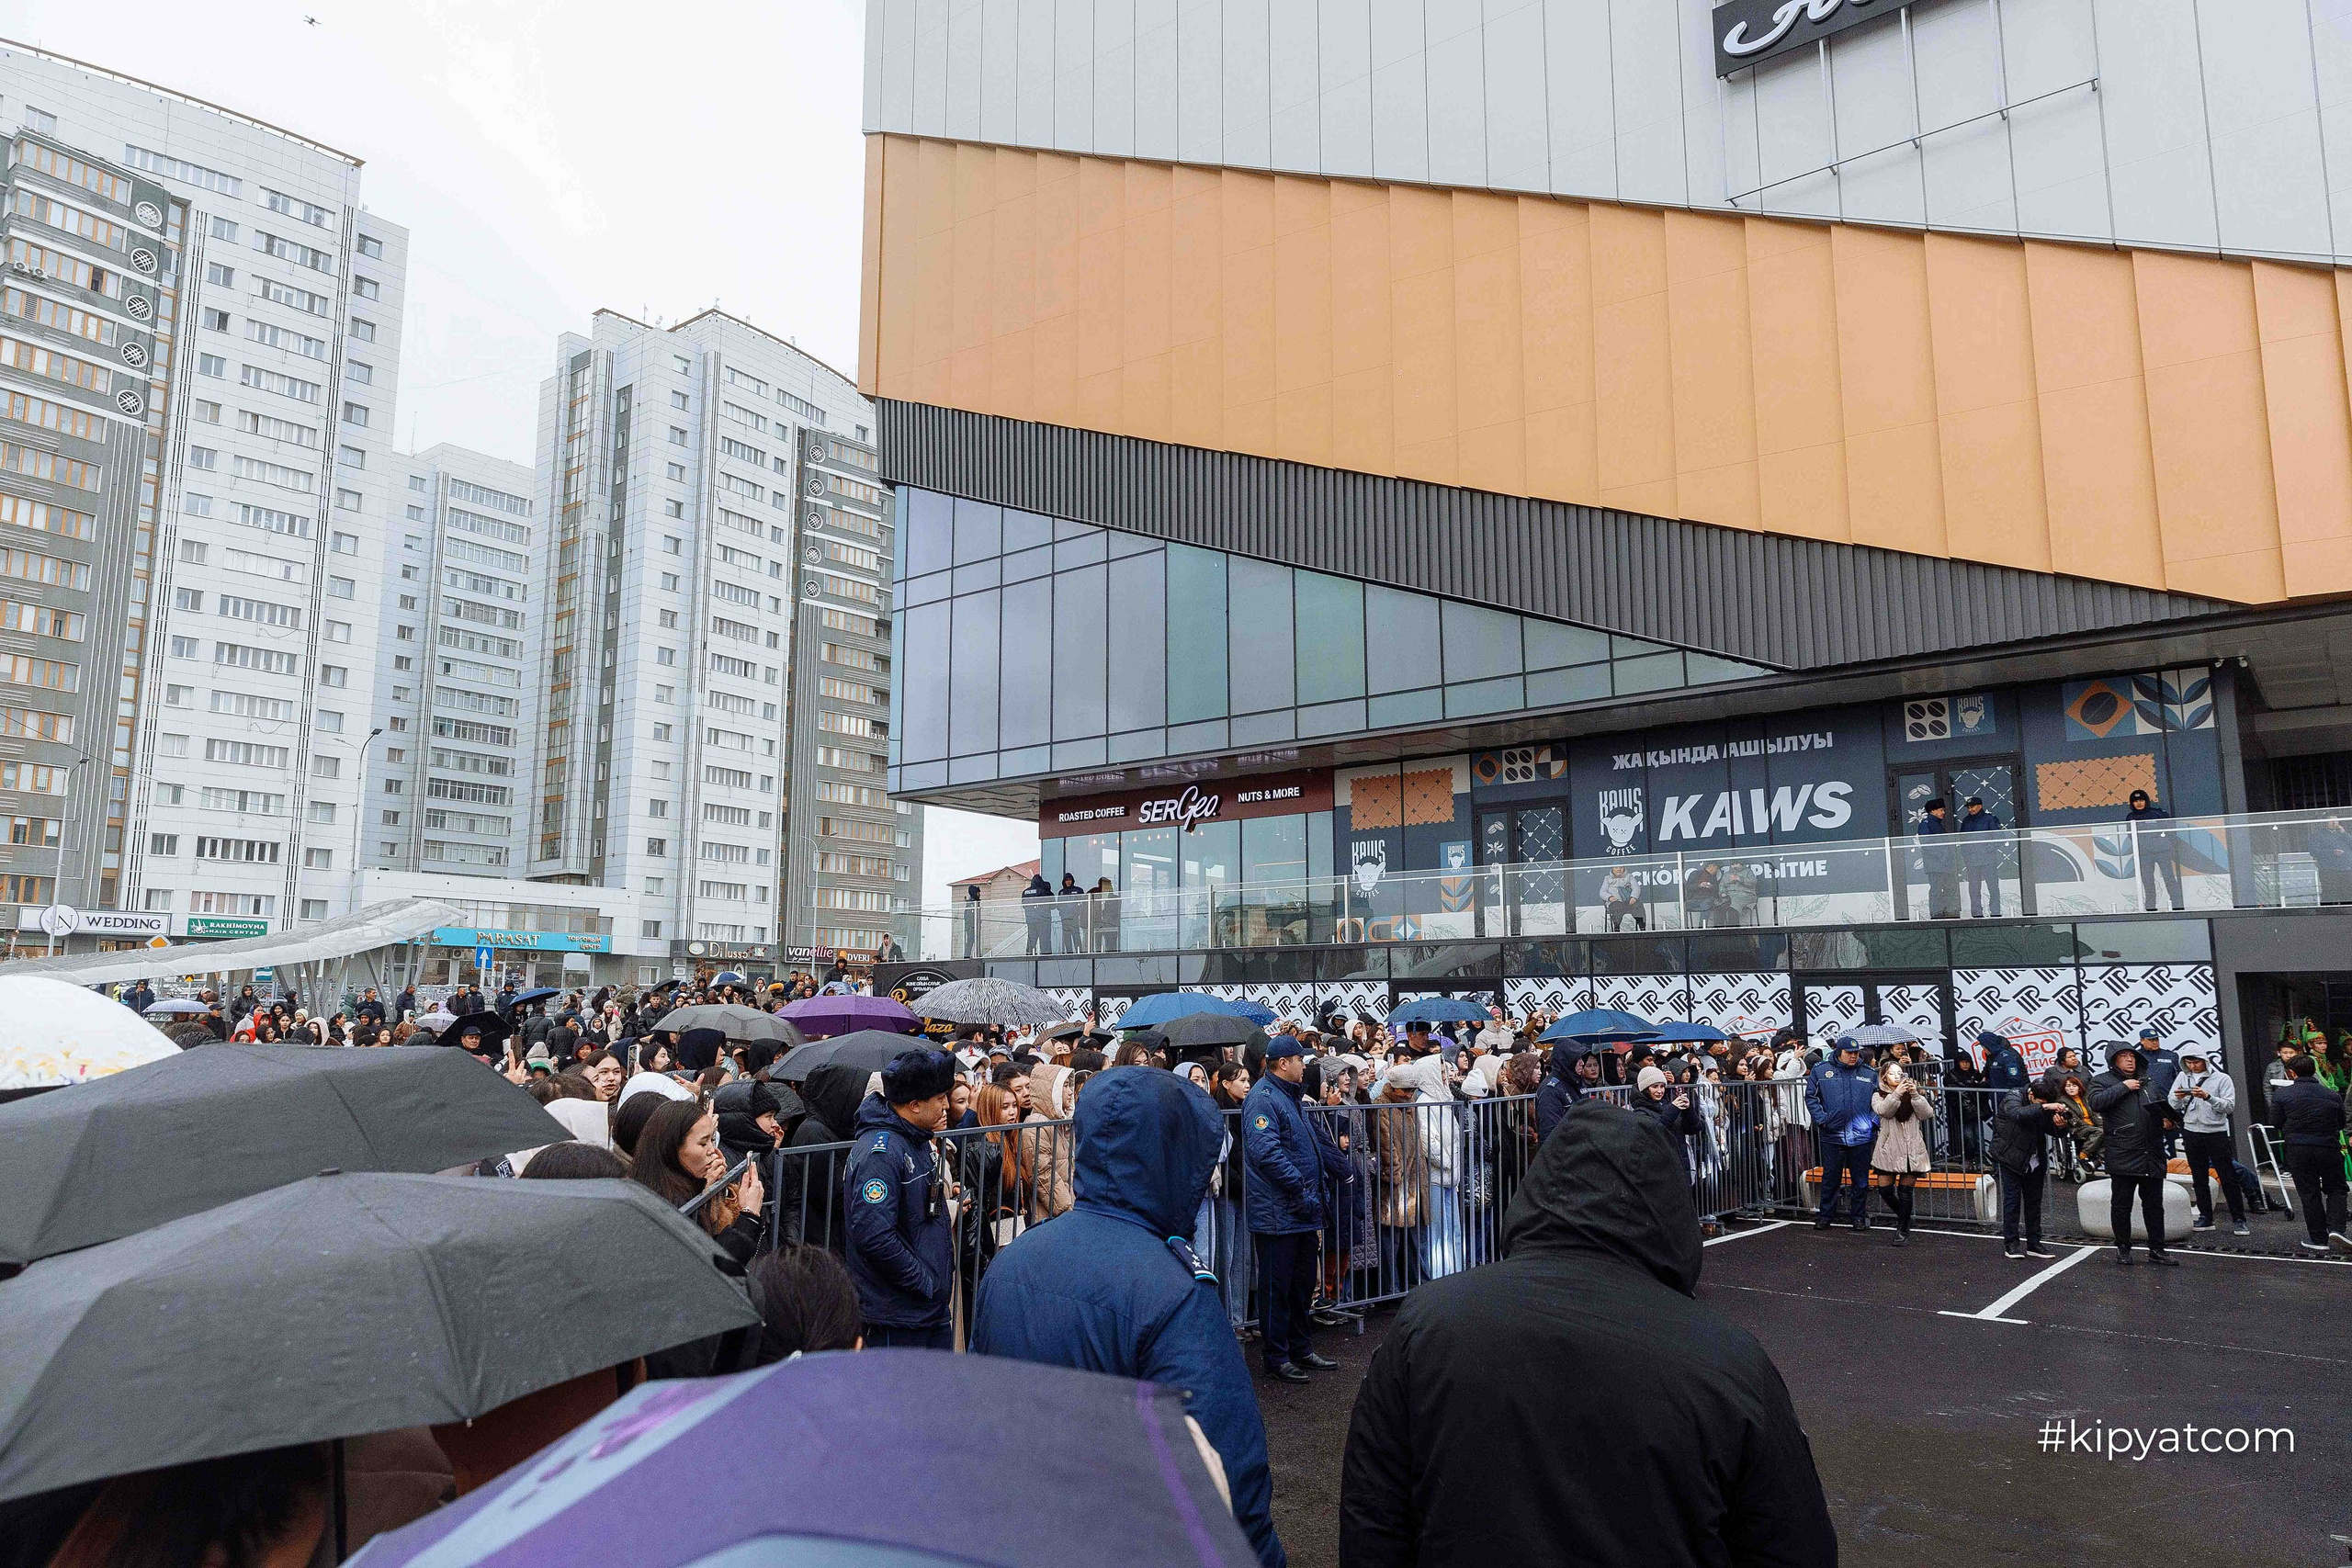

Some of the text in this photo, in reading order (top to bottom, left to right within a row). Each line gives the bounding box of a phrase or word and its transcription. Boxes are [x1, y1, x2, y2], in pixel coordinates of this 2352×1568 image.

[1612, 732, 1833, 770] ЖАҚЫНДА АШЫЛУЫ
[1238, 786, 1300, 803] NUTS & MORE
[1058, 807, 1125, 822] ROASTED COFFEE
[1658, 781, 1854, 841] KAWS
[1606, 843, 1636, 856] COFFEE
[1356, 887, 1380, 899] COFFEE
[85, 916, 162, 931] WEDDING
[209, 921, 266, 930] RAKHIMOVNA
[476, 931, 540, 947] PARASAT
[847, 953, 870, 962] DVERI
